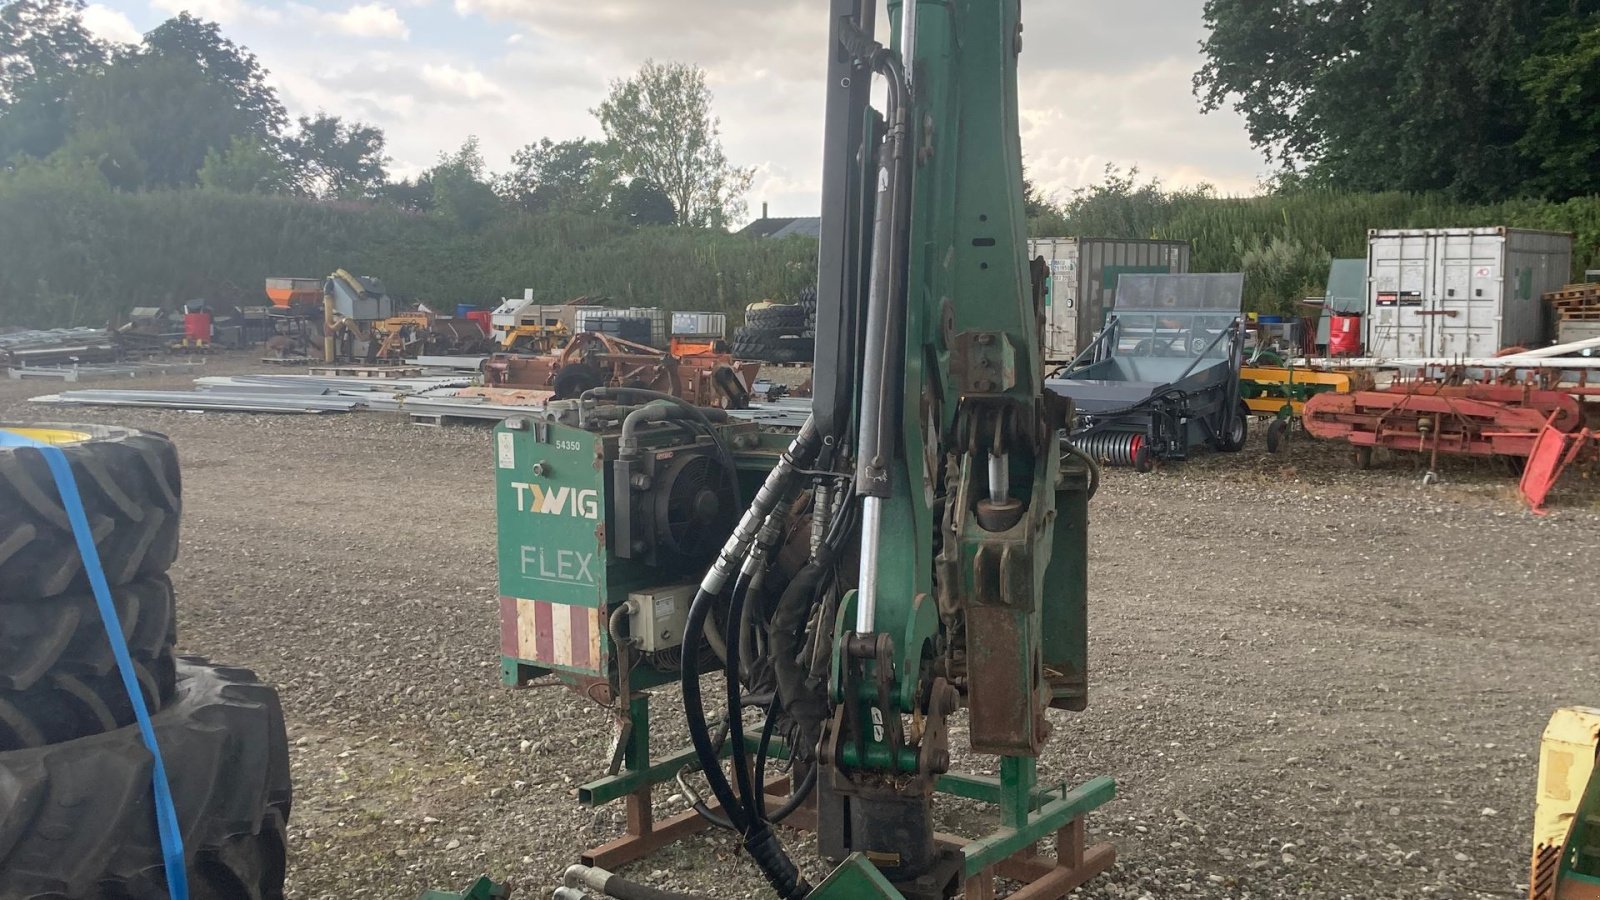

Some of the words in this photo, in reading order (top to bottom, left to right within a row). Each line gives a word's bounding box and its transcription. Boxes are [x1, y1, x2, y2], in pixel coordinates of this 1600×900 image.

[556, 440, 580, 451] 54350
[511, 482, 598, 519] TWIG
[521, 545, 594, 582] FLEX
